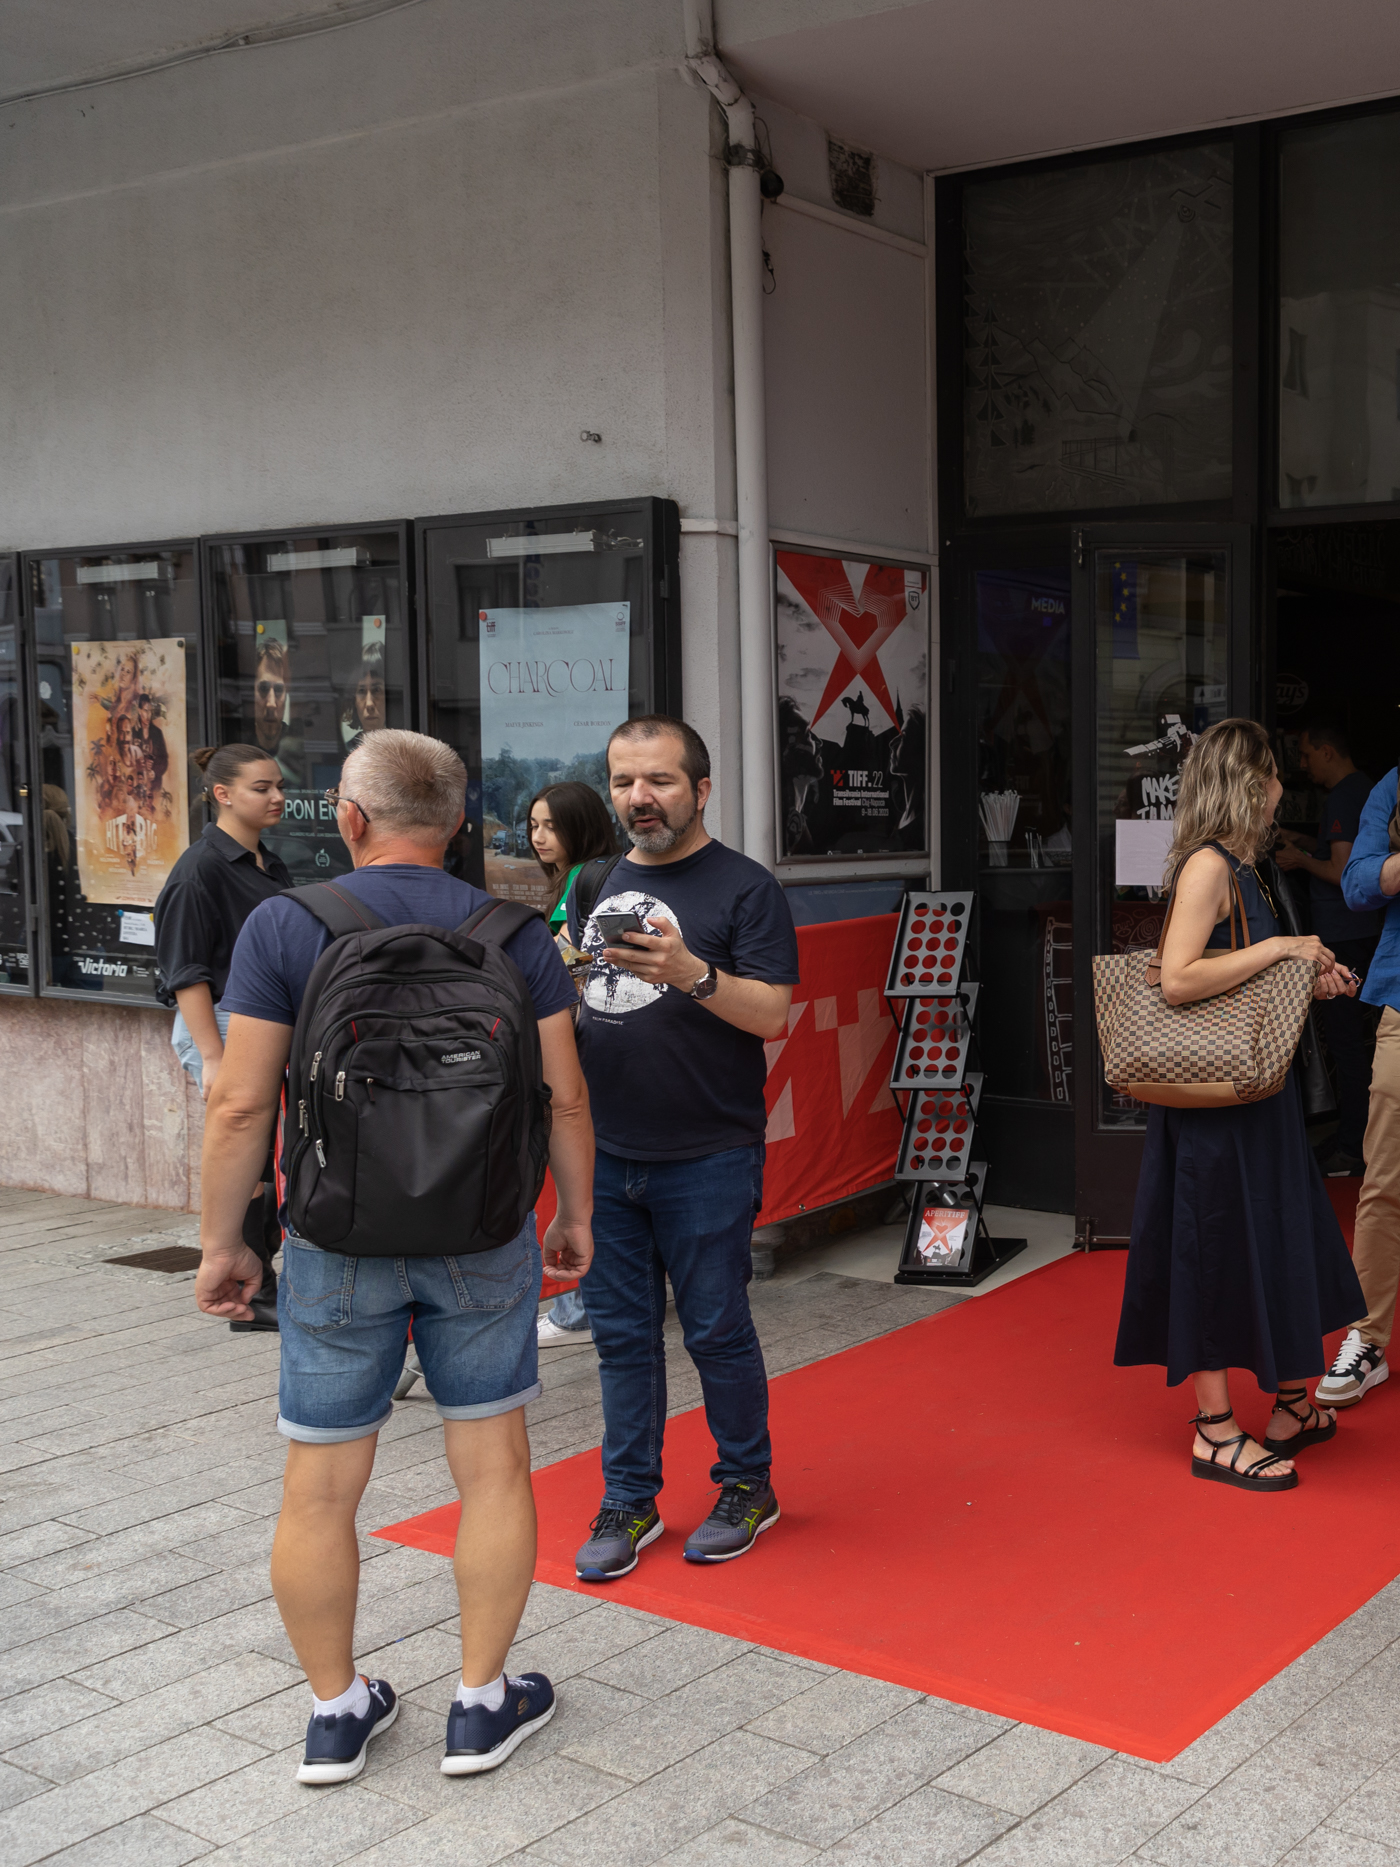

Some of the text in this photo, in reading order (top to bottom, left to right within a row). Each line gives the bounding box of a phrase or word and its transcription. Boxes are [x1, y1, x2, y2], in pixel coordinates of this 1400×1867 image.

[1032, 597, 1065, 614] MEDIA
[488, 658, 626, 697] CHARCOAL
[861, 790, 889, 798] International
[78, 957, 128, 977] Victoria
[441, 1050, 480, 1060] AMERICAN
[441, 1055, 481, 1064] TOURISTER
[925, 1210, 965, 1218] APERITIFF
